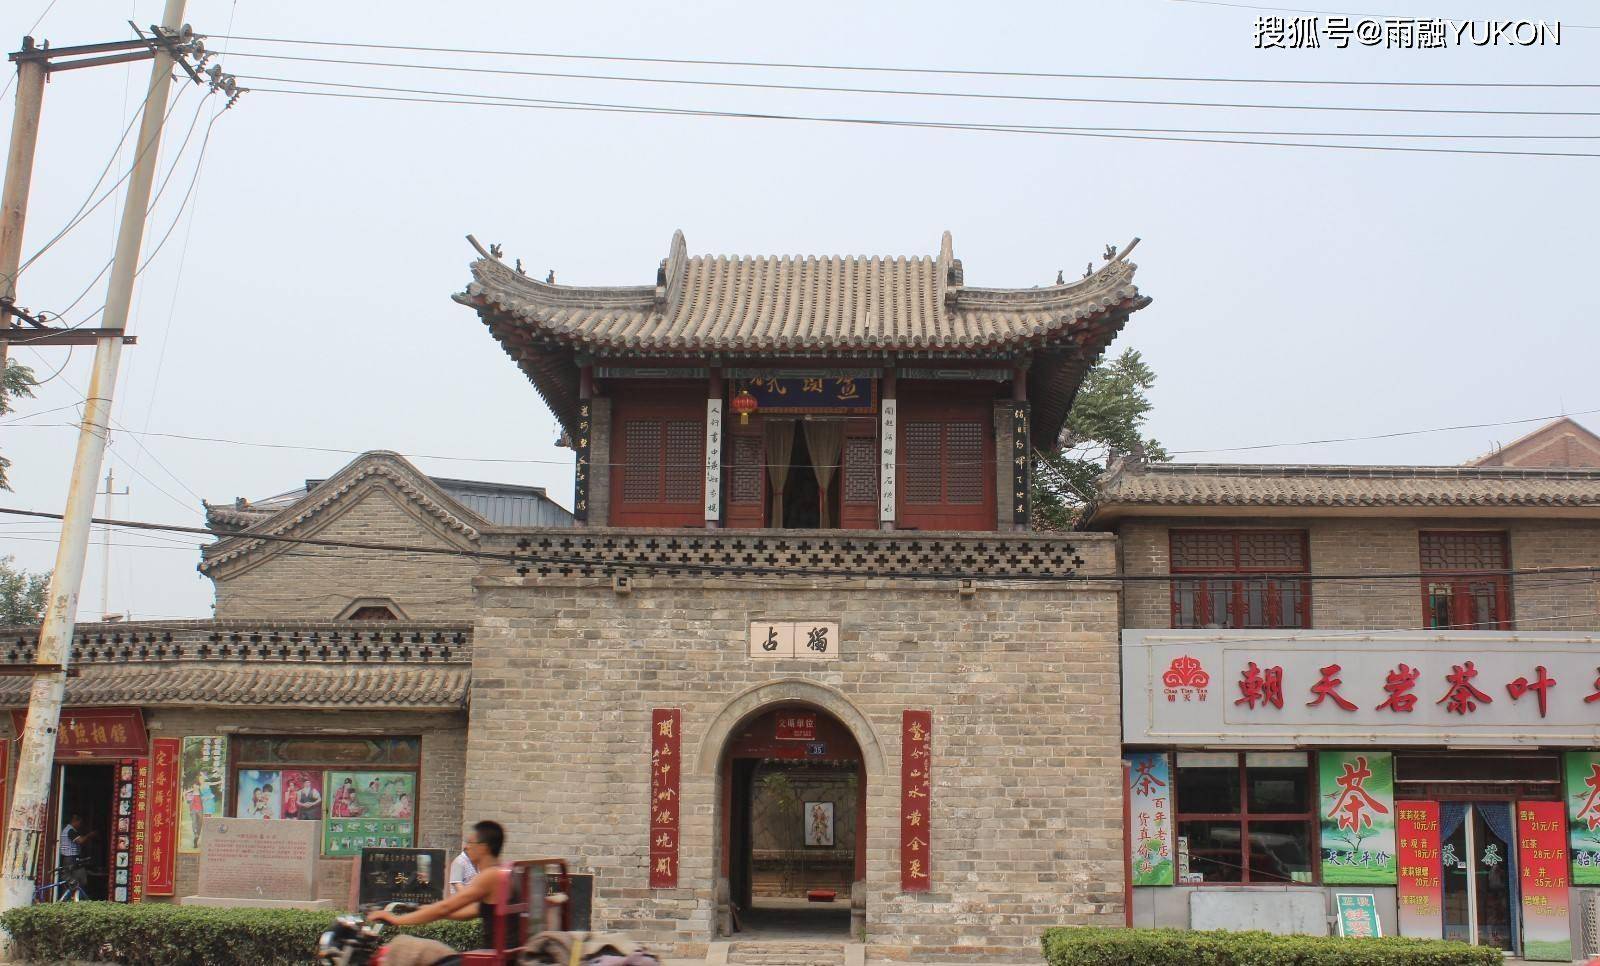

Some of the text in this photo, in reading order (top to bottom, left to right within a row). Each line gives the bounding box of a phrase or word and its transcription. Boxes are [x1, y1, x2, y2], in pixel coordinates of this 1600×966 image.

[1130, 757, 1166, 797] 茶
[1327, 755, 1389, 834] 茶
[1399, 810, 1427, 821] 茉莉花茶
[1152, 797, 1169, 857] 百年老店
[1413, 821, 1438, 831] 10元/斤
[1531, 821, 1559, 832] 21元/斤
[1521, 838, 1537, 849] 红茶
[1328, 850, 1391, 868] 天天平价
[1481, 843, 1503, 867] 茶
[1533, 849, 1564, 860] 28元/斤
[1535, 877, 1566, 888] 35元/斤
